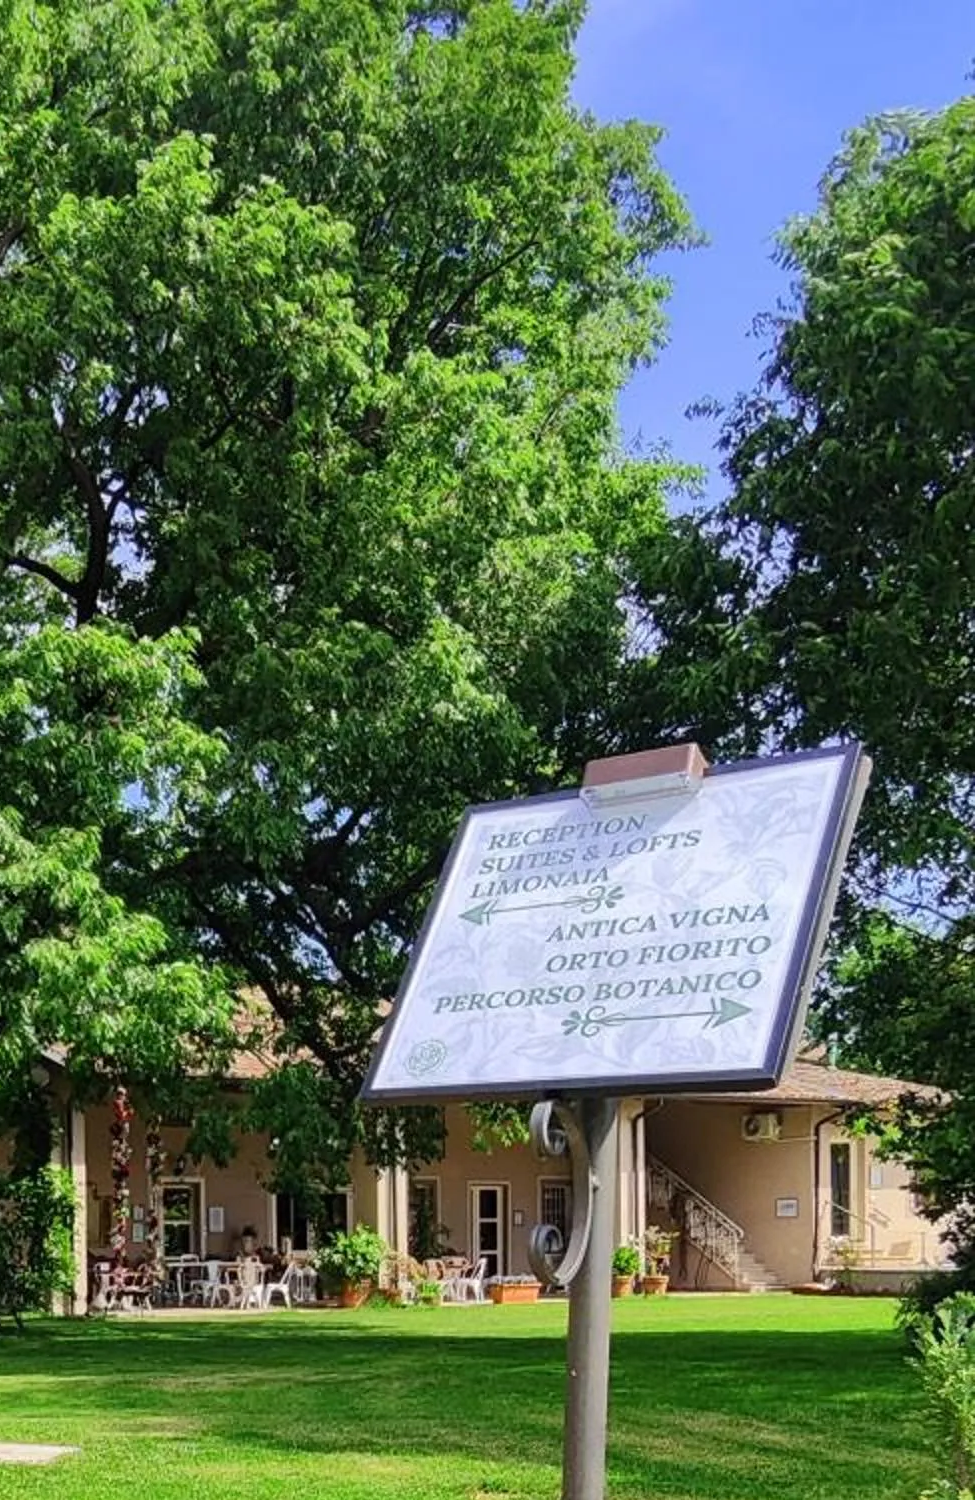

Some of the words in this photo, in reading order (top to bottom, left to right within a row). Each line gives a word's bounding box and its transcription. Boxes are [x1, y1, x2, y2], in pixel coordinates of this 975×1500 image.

[488, 815, 647, 850] RECEPTION
[480, 848, 573, 875] SUITES
[582, 845, 599, 862] &
[609, 830, 701, 858] LOFTS
[470, 867, 608, 898] LIMONAIA
[546, 915, 656, 942] ANTICA
[669, 904, 769, 929] VIGNA
[546, 948, 627, 972] ORTO
[638, 936, 770, 965] FIORITO
[433, 984, 584, 1013] PERCORSO
[594, 969, 761, 1002] BOTANICO
